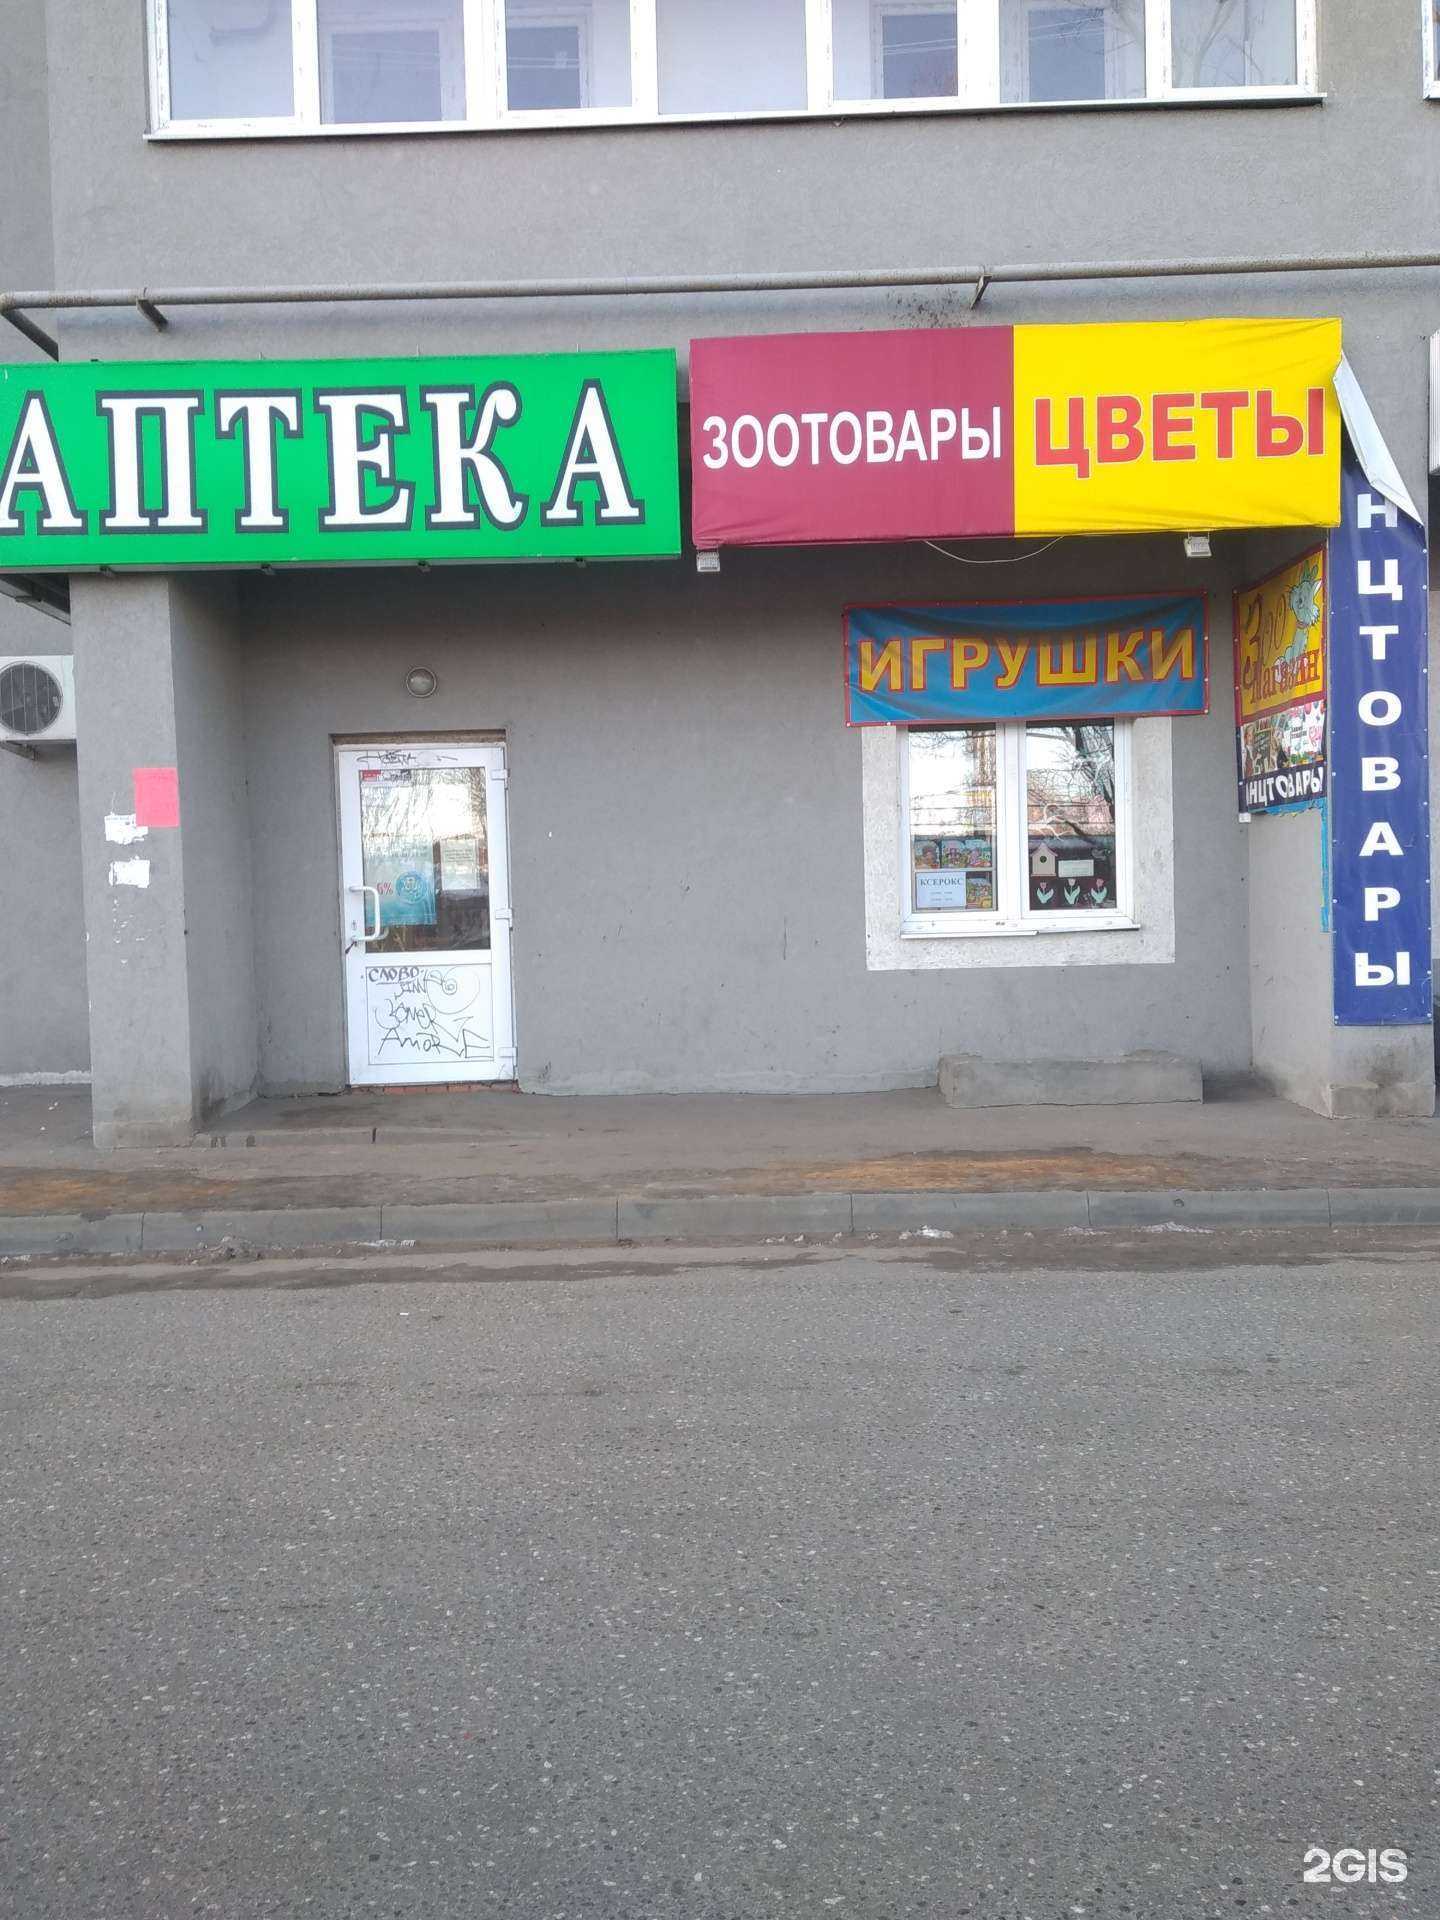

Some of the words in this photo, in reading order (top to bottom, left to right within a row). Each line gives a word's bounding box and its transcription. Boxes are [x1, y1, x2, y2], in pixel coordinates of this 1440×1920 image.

[0, 380, 646, 535] АПТЕКА
[702, 406, 1001, 470] ЗООТОВАРЫ
[1034, 387, 1326, 480] ЦВЕТЫ
[858, 627, 1198, 693] ИГРУШКИ
[1245, 767, 1324, 806] НЦТОВАРЫ
[920, 876, 963, 887] КСЕРОКС
